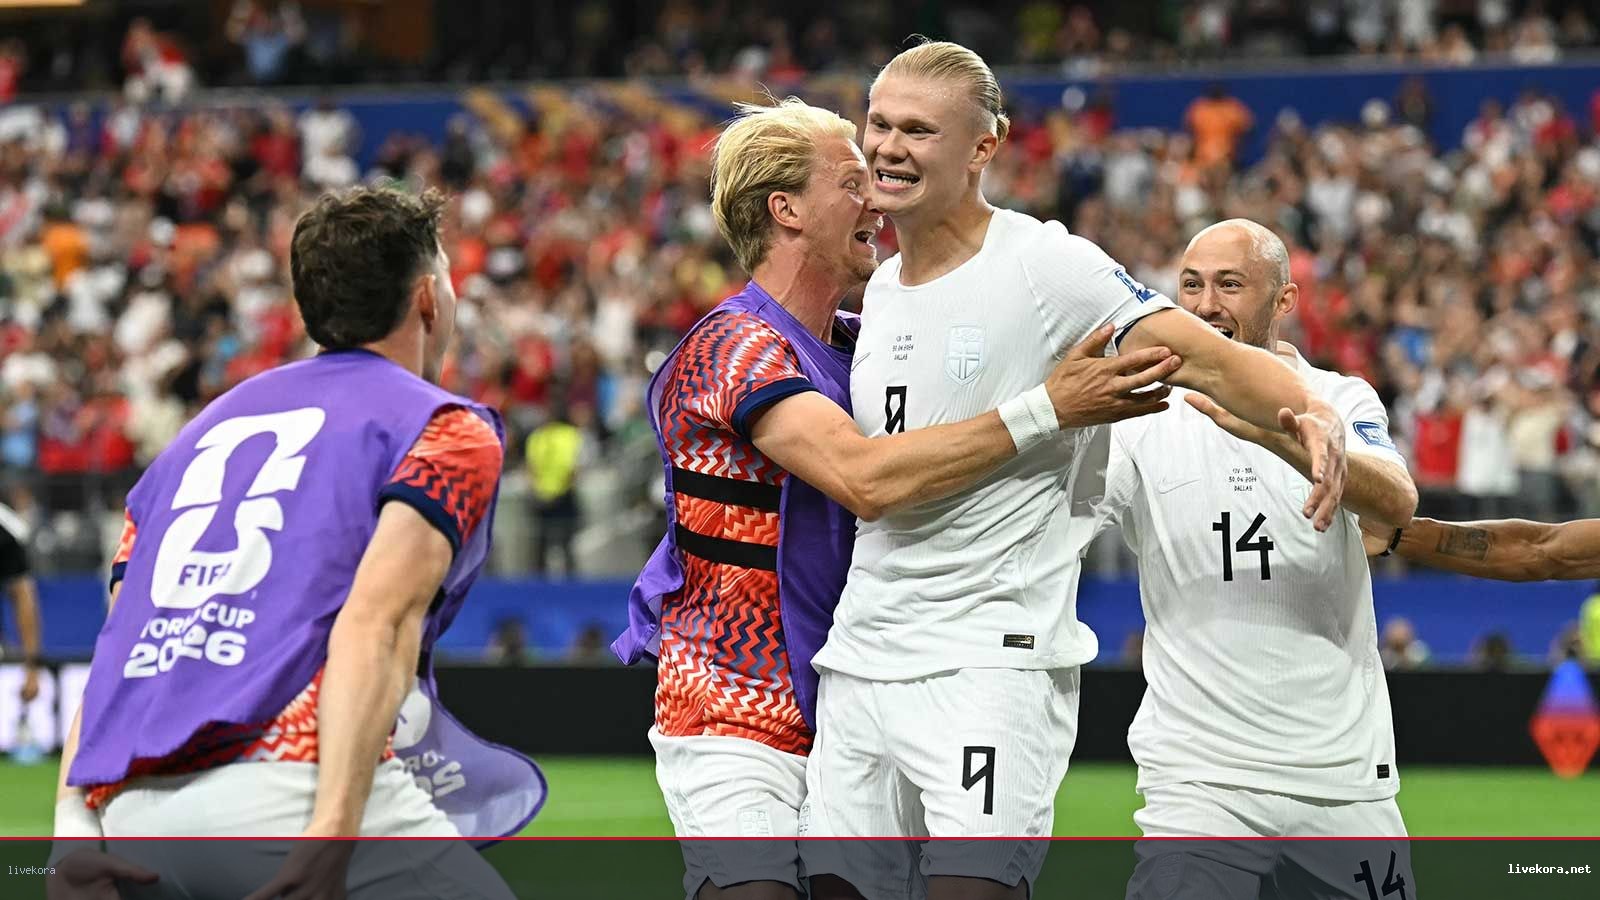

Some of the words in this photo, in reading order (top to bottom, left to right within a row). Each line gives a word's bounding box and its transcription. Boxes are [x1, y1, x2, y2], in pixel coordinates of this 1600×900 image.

[884, 385, 907, 435] 9
[1212, 511, 1274, 581] 14
[200, 601, 256, 629] CUP
[123, 624, 247, 679] 2026
[961, 746, 996, 815] 9
[1353, 850, 1407, 900] 14
